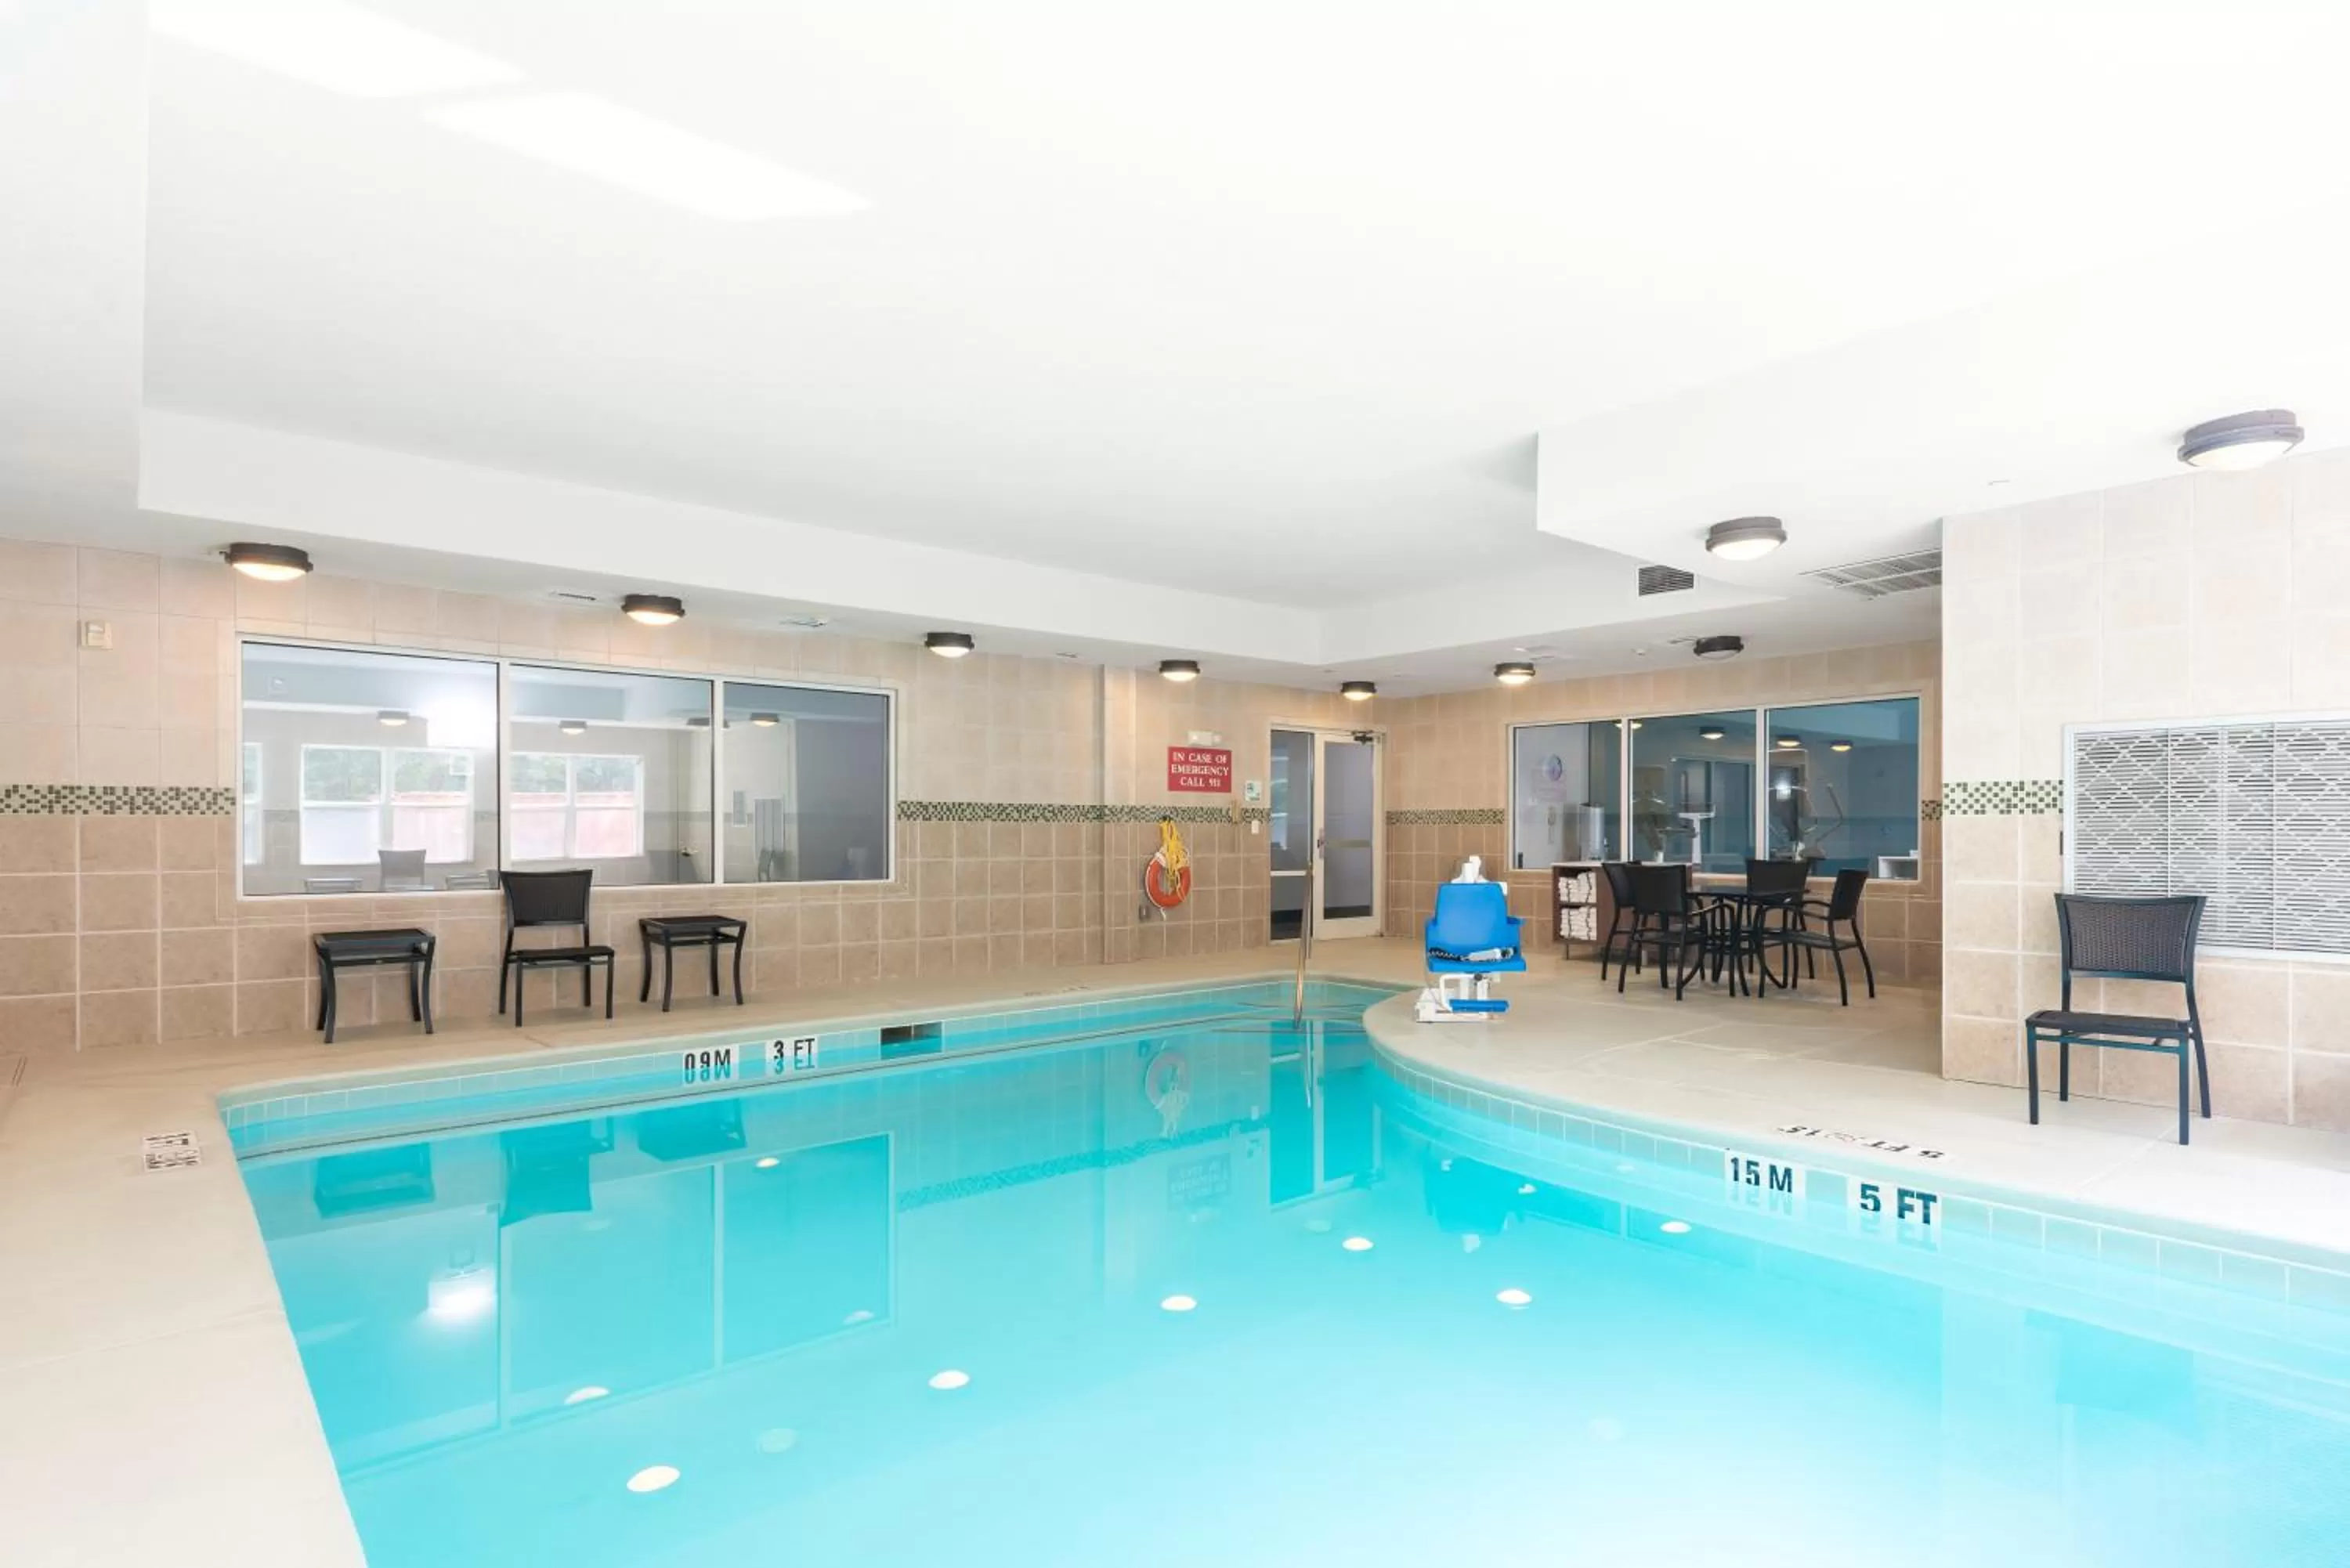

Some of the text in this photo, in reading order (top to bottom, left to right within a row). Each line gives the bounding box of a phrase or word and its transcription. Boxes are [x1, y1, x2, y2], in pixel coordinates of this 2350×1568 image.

[1173, 751, 1227, 764] IN CASE OF
[1171, 764, 1229, 776] EMERGENCY
[1180, 776, 1205, 787] CALL
[774, 1039, 784, 1060] 3
[1860, 1183, 1937, 1225] 5 FT
